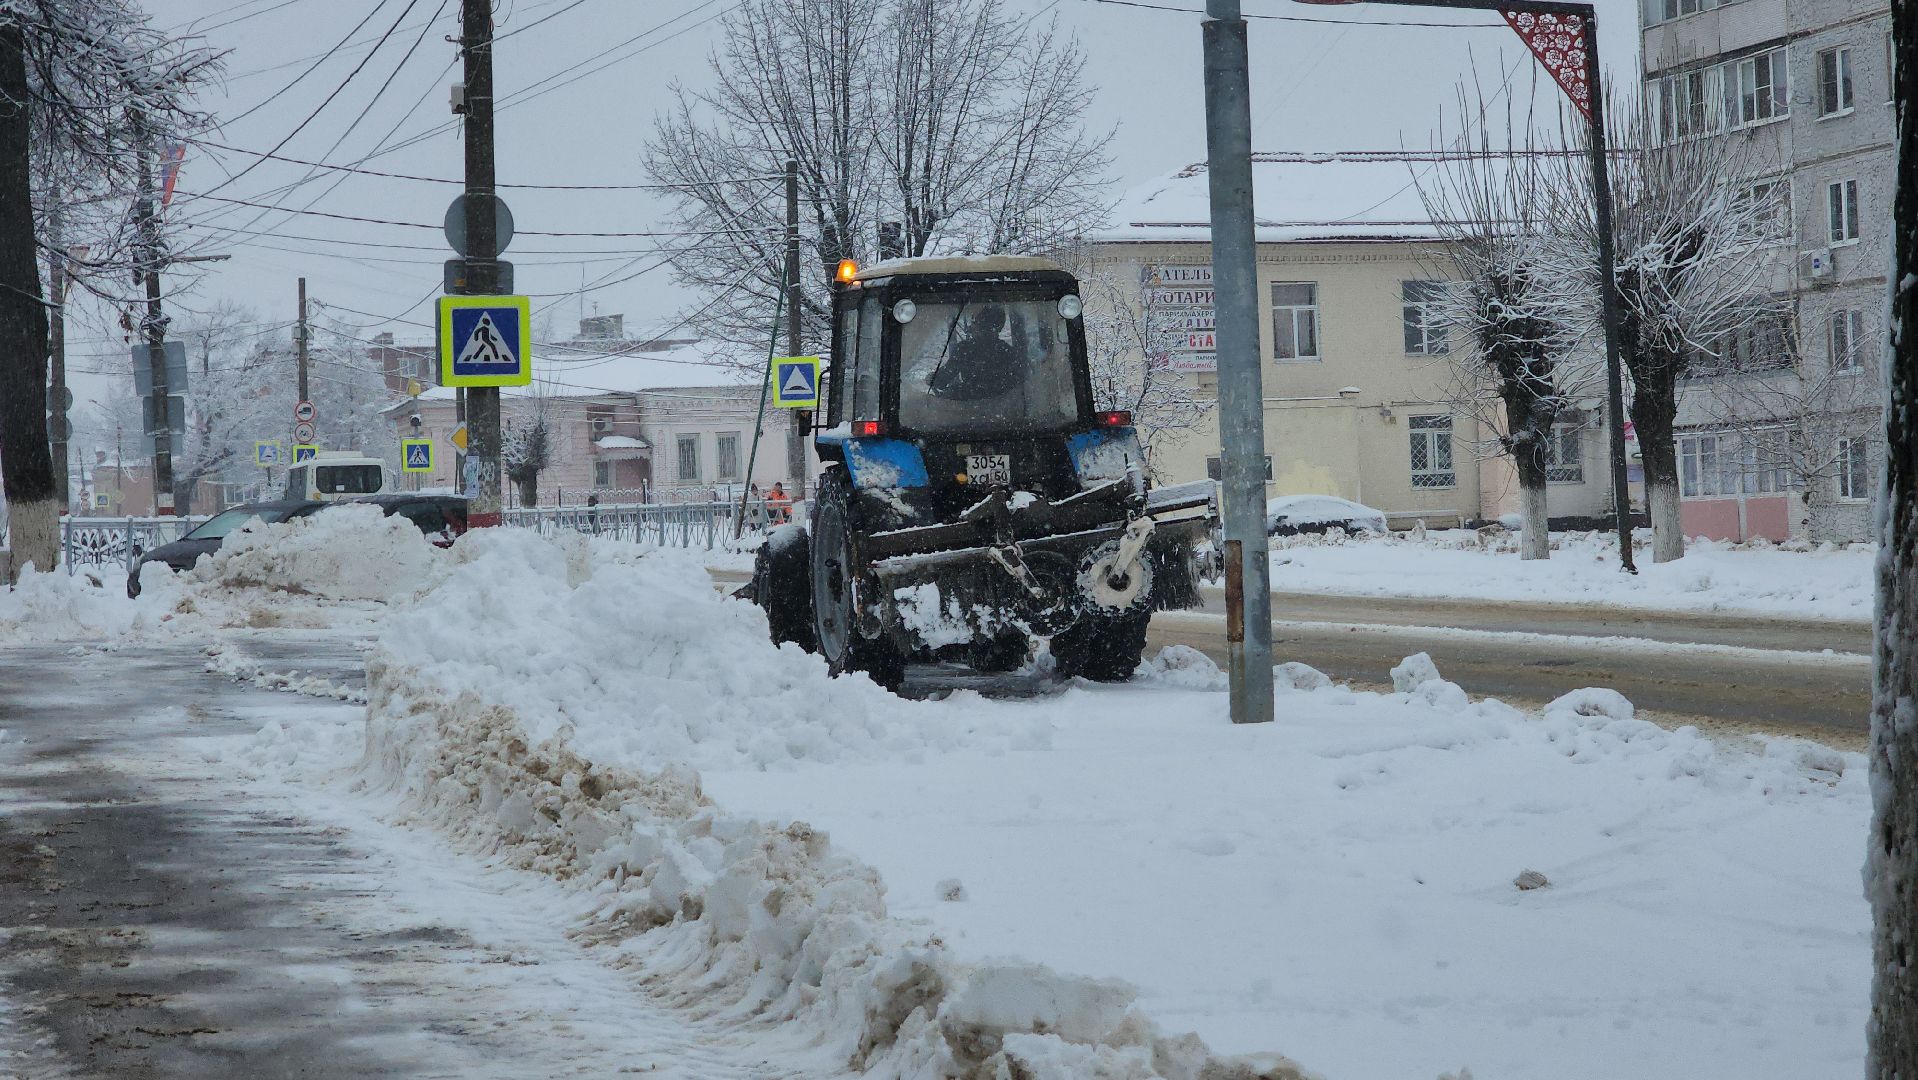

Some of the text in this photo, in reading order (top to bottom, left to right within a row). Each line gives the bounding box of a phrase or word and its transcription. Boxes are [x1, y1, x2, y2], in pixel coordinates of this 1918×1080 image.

[1162, 269, 1211, 281] АТЕЛЬ
[1152, 291, 1215, 304] ОТАРИ
[1189, 334, 1214, 347] СТА
[971, 456, 1005, 469] 3054
